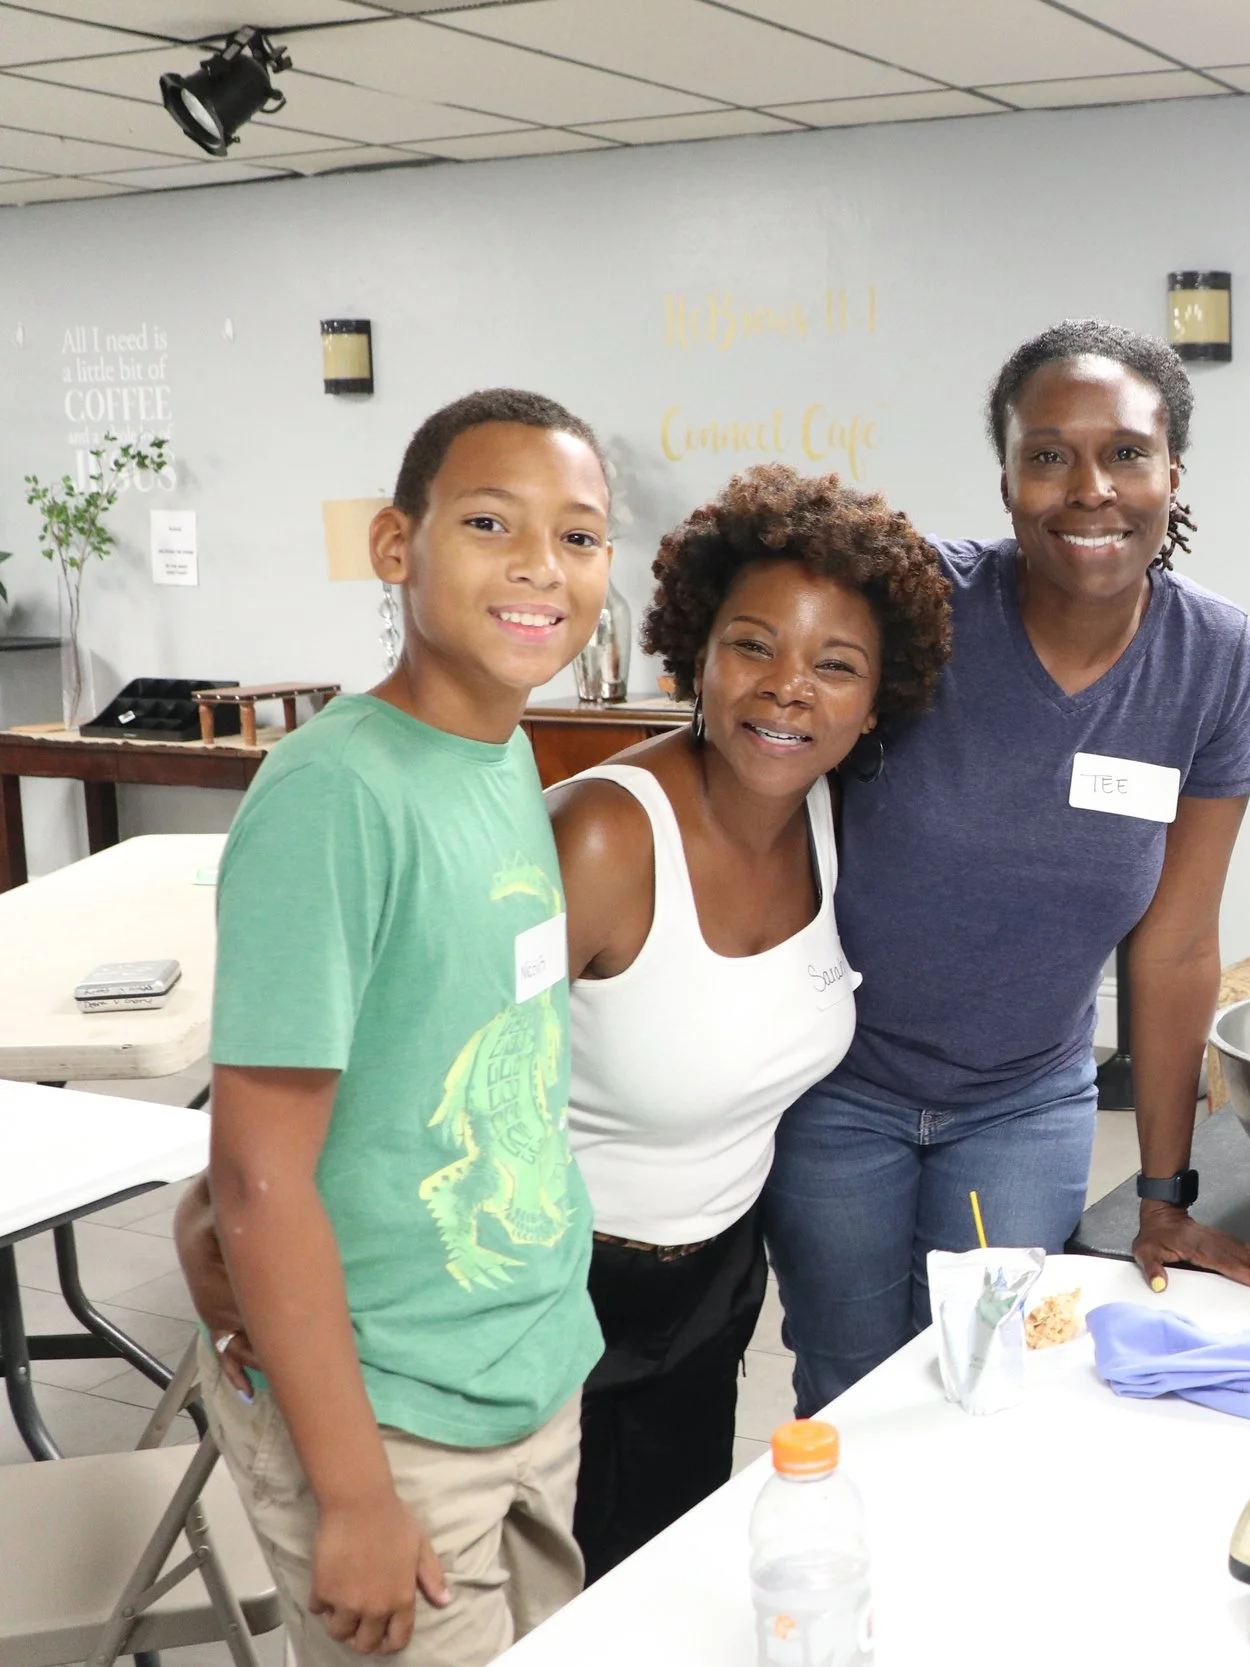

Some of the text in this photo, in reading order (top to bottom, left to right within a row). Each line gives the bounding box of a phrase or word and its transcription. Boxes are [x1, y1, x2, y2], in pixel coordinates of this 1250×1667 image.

[62, 323, 168, 354] All I need is
[62, 353, 168, 383] a little bit of
[64, 386, 172, 422] COFFEE
[67, 425, 89, 444] and
[1080, 773, 1129, 794] TEE
